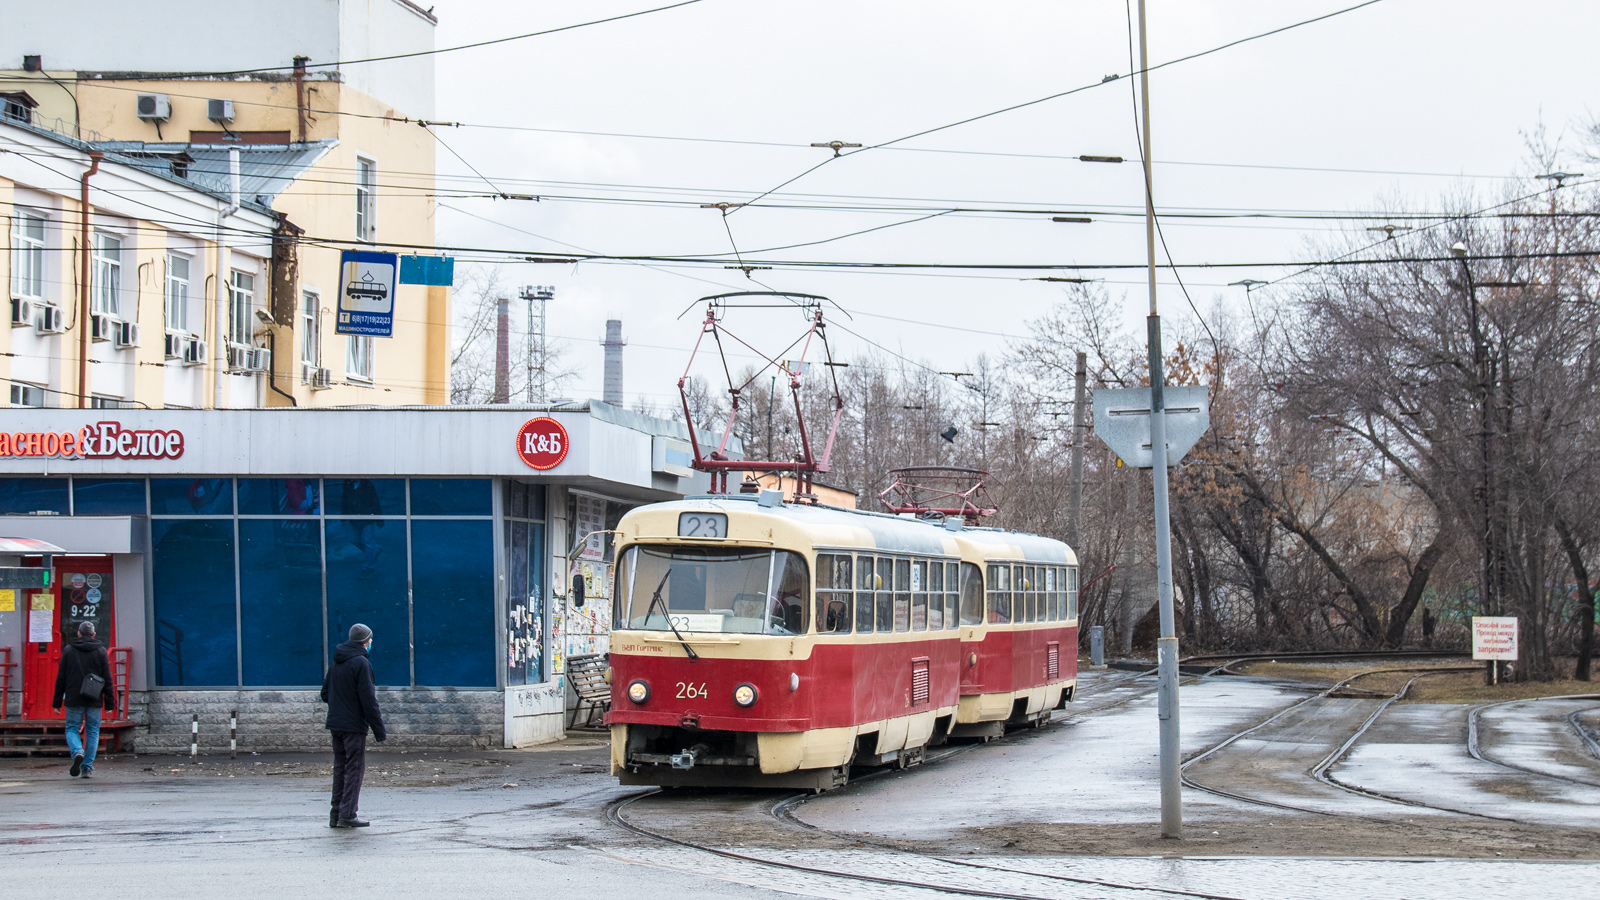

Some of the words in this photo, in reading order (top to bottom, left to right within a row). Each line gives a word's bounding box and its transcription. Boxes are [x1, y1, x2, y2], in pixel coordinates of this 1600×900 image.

[523, 432, 562, 454] К&Б
[687, 516, 718, 538] 23
[669, 616, 690, 631] 23
[675, 681, 709, 700] 264
